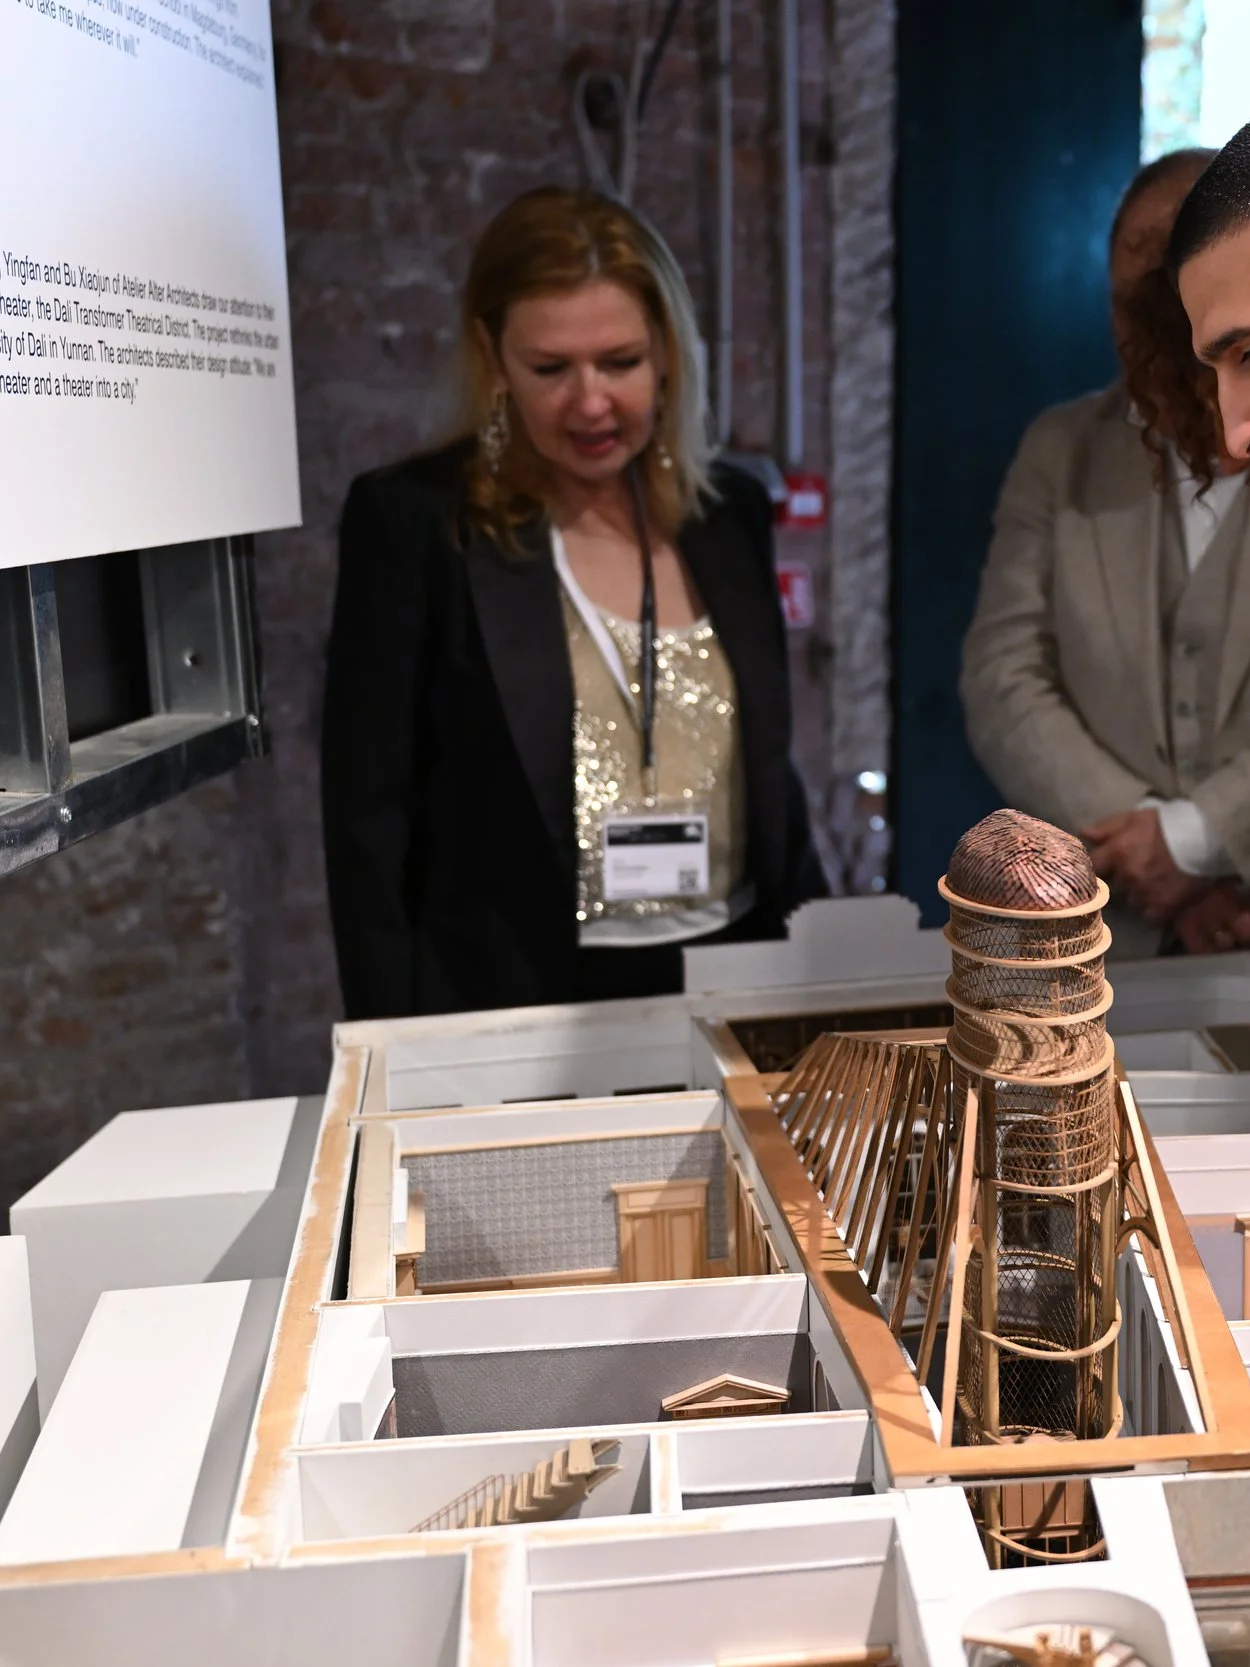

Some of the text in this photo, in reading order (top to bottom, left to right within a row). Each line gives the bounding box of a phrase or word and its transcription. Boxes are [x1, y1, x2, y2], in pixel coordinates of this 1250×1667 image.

[59, 4, 73, 27] me
[75, 10, 114, 47] wherever
[3, 250, 41, 286] Yingfan
[44, 261, 61, 285] and
[63, 262, 77, 288] Bu
[79, 265, 111, 298] Xiaojun
[112, 273, 120, 295] of
[122, 274, 147, 299] Atelier
[0, 293, 34, 322] heater,
[36, 296, 52, 321] the
[54, 298, 72, 322] Dali
[73, 301, 125, 330] Transformer
[126, 309, 164, 335] Theatrical
[0, 329, 13, 361] ity
[15, 331, 25, 356] of
[28, 332, 47, 357] Dali
[49, 334, 58, 358] in
[59, 336, 97, 362] Yunnan.
[98, 340, 115, 364] The
[117, 343, 154, 367] architects
[0, 371, 31, 395] heater
[33, 371, 52, 396] and
[54, 377, 61, 396] a
[62, 372, 93, 398] theater
[95, 374, 112, 399] into
[113, 381, 119, 399] a
